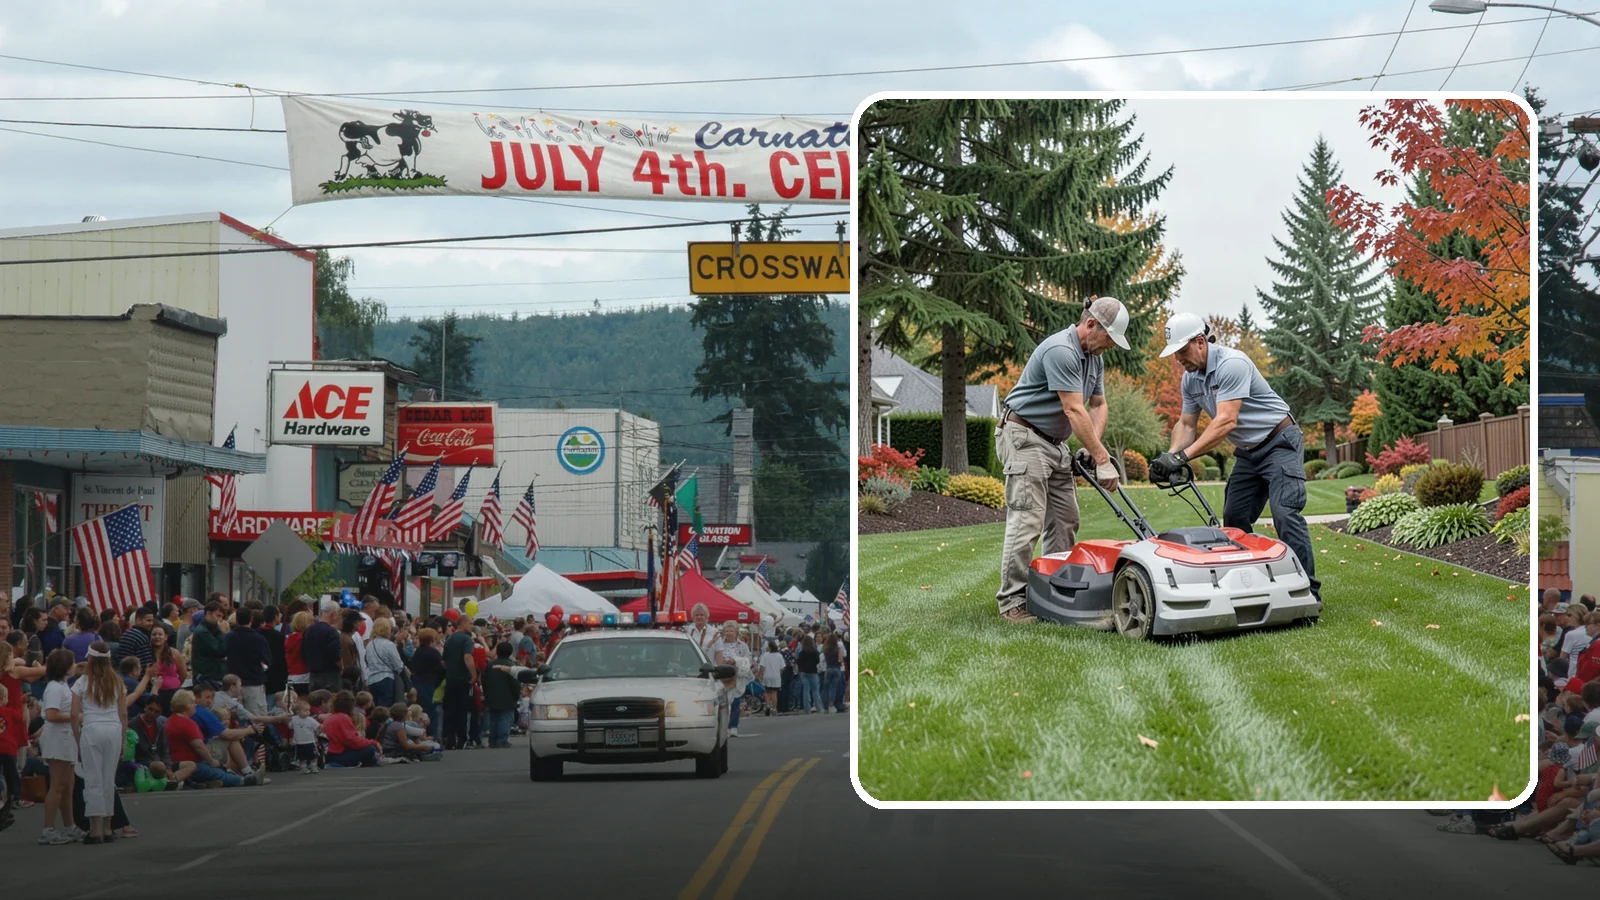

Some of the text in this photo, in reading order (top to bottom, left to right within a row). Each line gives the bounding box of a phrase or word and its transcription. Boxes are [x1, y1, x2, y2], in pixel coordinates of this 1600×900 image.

[695, 121, 850, 149] Carnat
[481, 141, 605, 192] JULY
[632, 150, 746, 198] 4th.
[697, 254, 850, 280] CROSSWA
[282, 380, 373, 419] ACE
[405, 409, 484, 421] CEDAR LOG
[284, 421, 370, 436] Hardware
[416, 428, 477, 447] Coca-Cola
[96, 485, 124, 495] Vincent
[126, 486, 136, 495] de
[138, 486, 155, 495] Paul
[699, 535, 730, 543] GLASS
